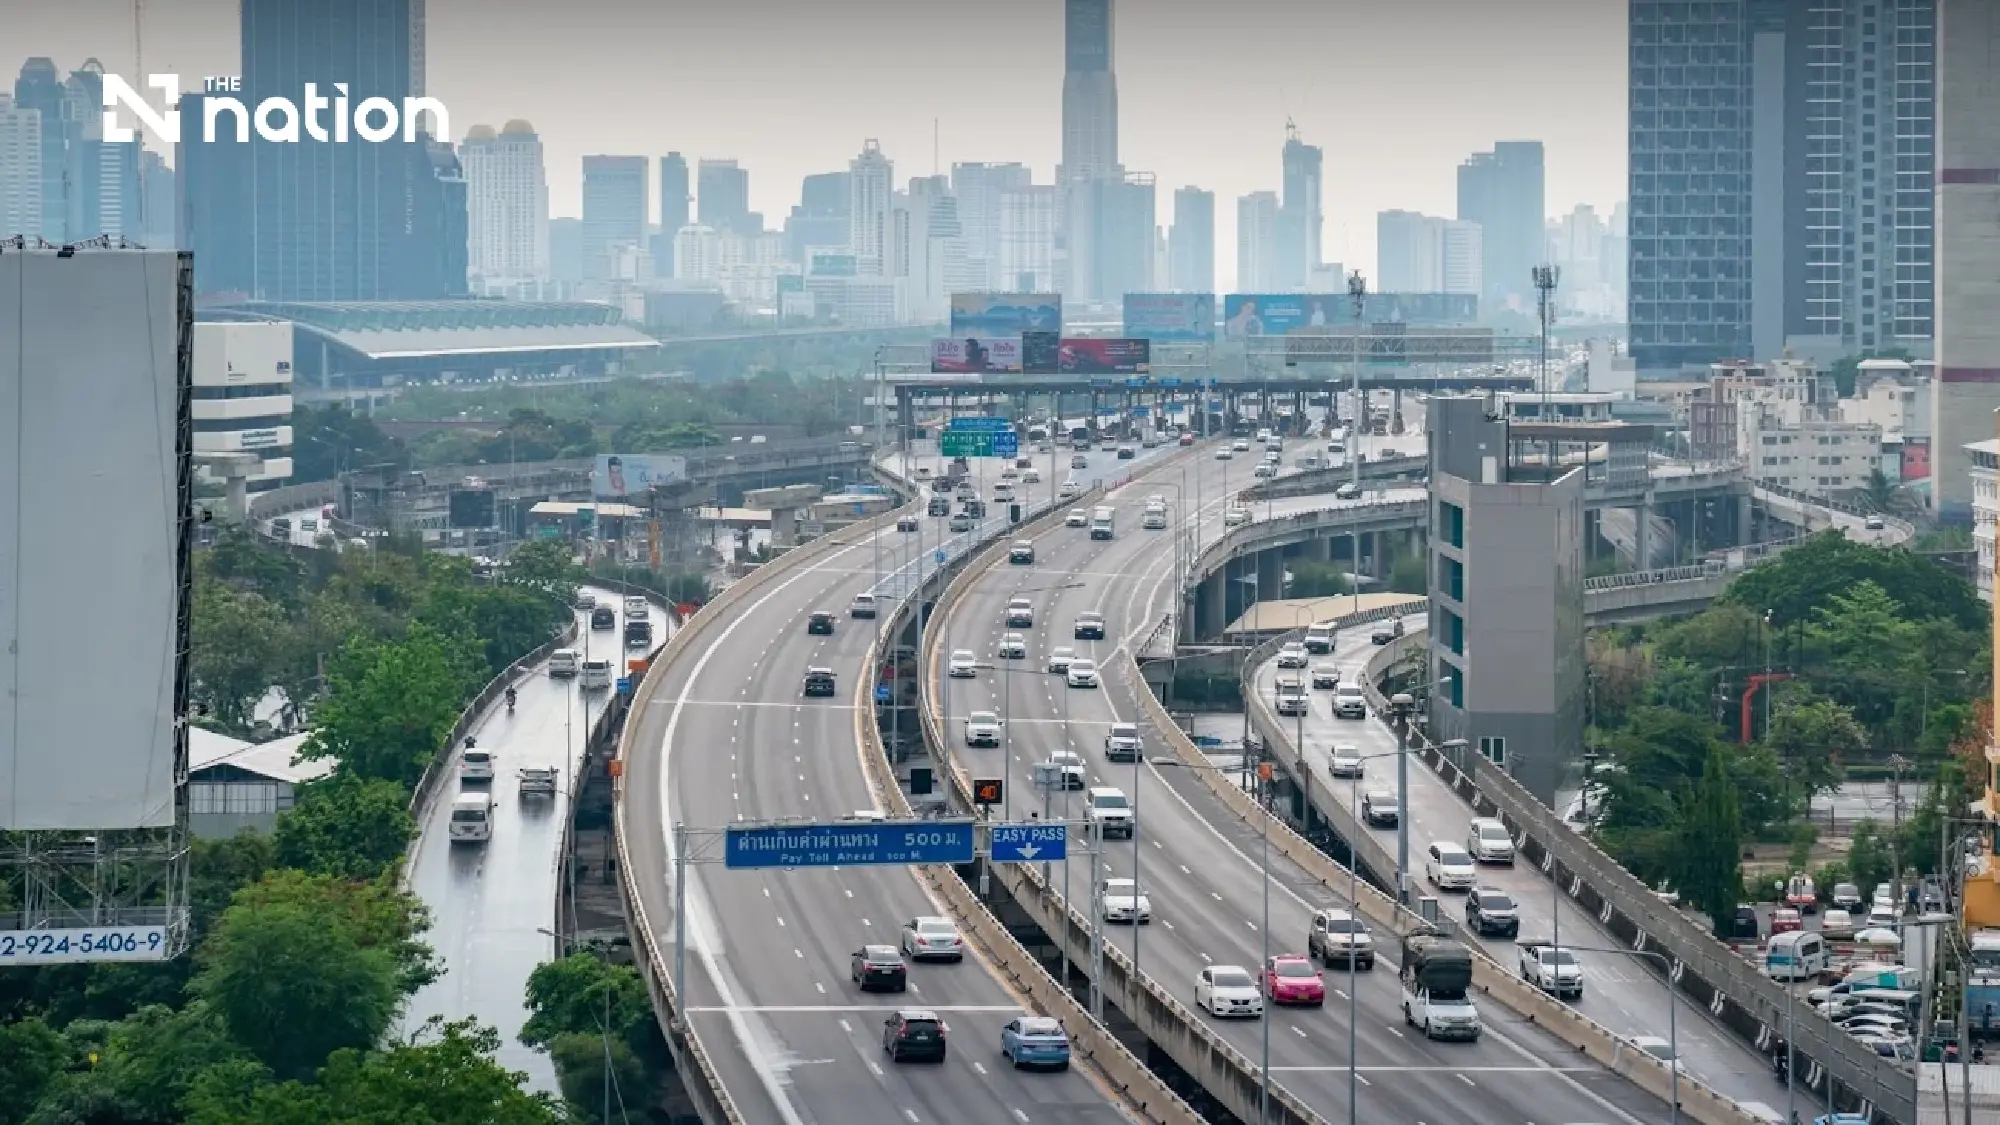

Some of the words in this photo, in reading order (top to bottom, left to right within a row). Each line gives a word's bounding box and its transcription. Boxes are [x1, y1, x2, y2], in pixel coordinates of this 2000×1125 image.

[904, 832, 941, 847] 500
[993, 829, 1027, 842] EASY
[1032, 828, 1064, 841] PASS
[780, 853, 802, 864] Pay
[809, 852, 829, 863] Toll
[837, 851, 875, 862] Ahead
[1, 932, 161, 956] 2-924-5406-9
